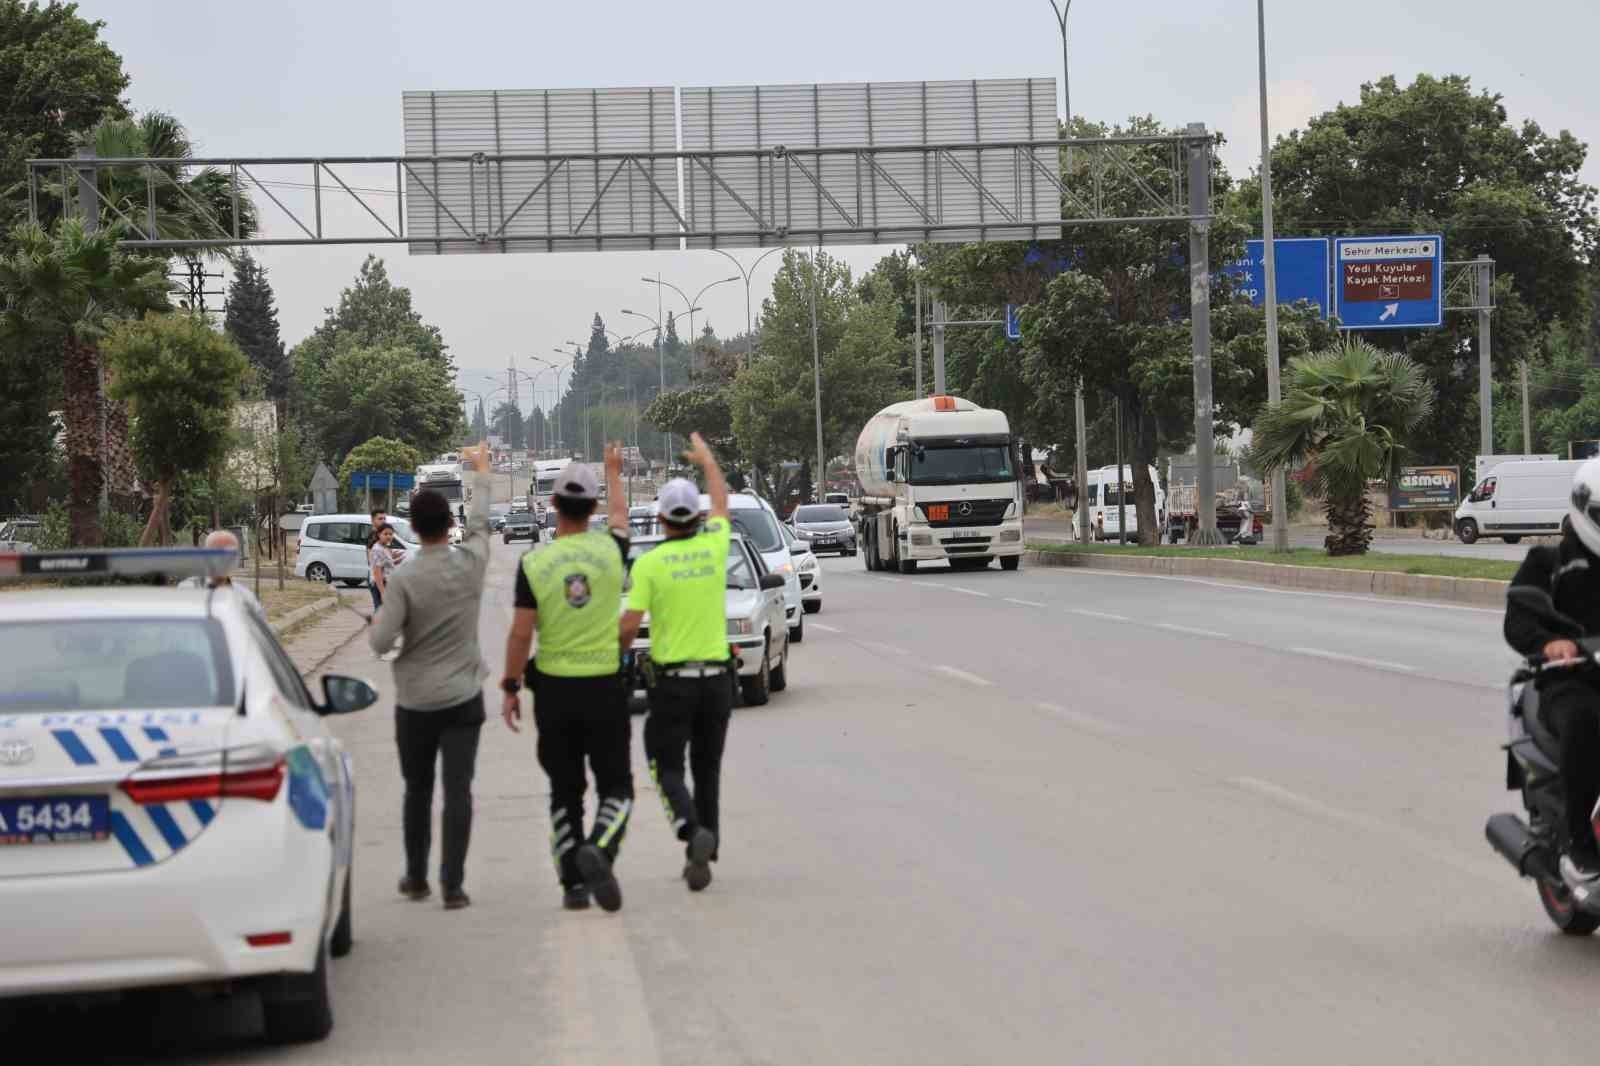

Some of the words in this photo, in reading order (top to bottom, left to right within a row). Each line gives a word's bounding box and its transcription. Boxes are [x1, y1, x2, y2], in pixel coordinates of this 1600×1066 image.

[1375, 245, 1418, 256] Merkezi
[1347, 264, 1371, 274] Yedi
[1375, 263, 1417, 274] Kuyular
[1346, 275, 1380, 286] Kayak
[1382, 273, 1426, 285] Merkezi
[16, 801, 92, 832] 5434
